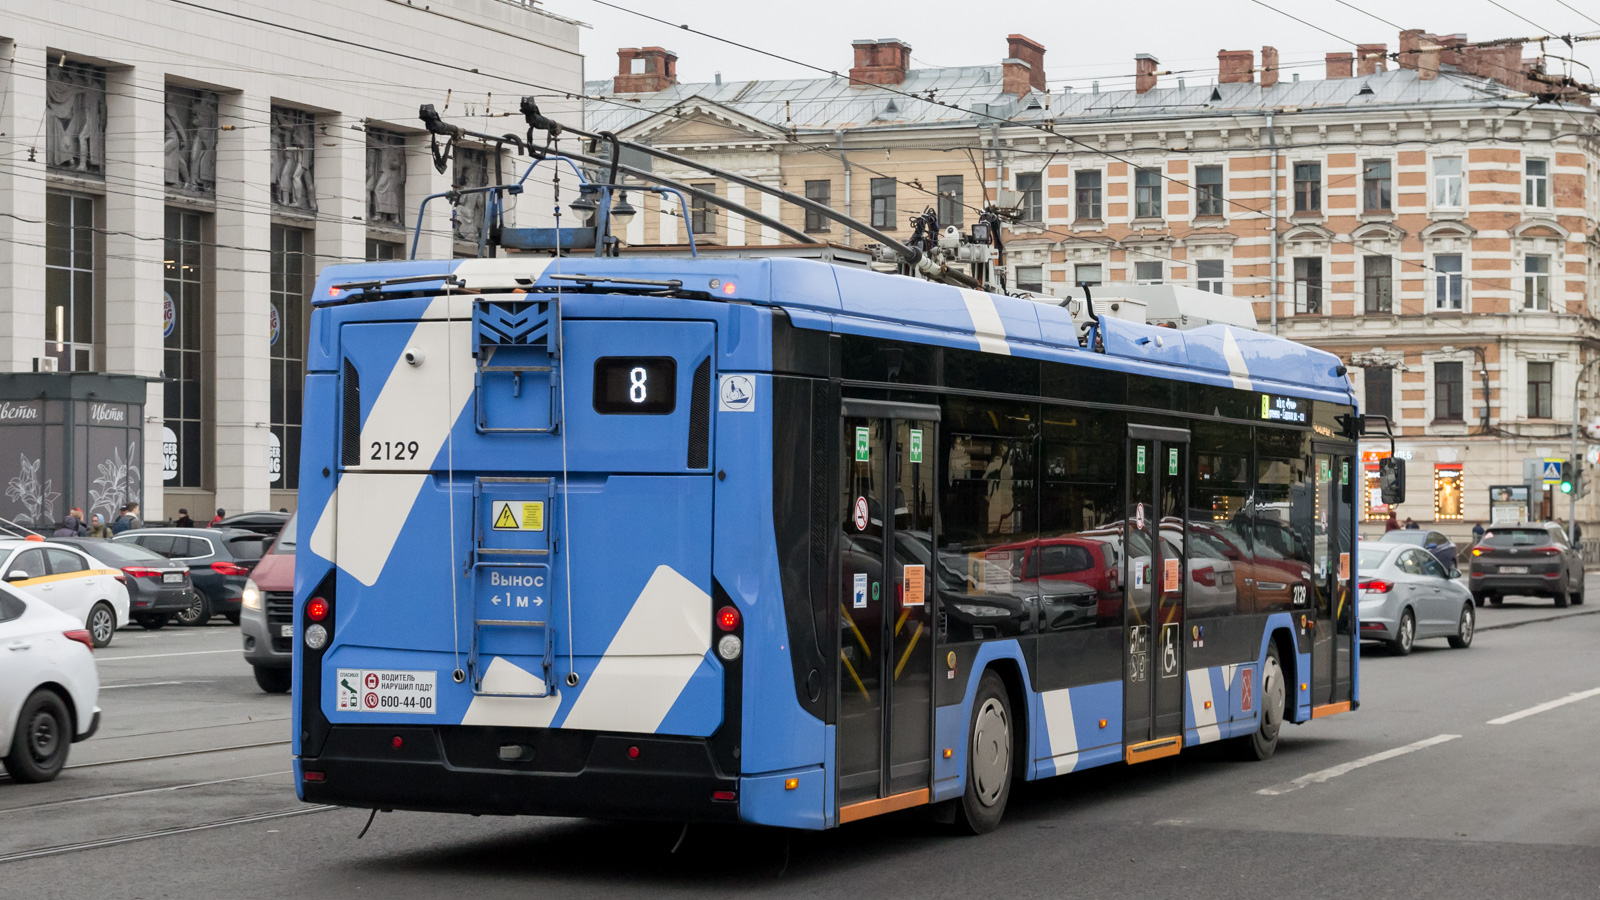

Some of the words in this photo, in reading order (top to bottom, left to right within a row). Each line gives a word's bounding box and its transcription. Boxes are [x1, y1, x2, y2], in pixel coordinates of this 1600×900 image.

[629, 367, 647, 403] 8
[0, 402, 39, 420] веты
[91, 403, 125, 423] Цветы
[371, 441, 419, 460] 2129
[491, 571, 544, 588] Вынос
[505, 592, 511, 607] 1
[1293, 585, 1307, 604] 2129
[381, 674, 415, 682] ВОДИТЕЛЬ
[381, 682, 413, 691] НАРУШИЛ
[415, 683, 433, 692] ПДД?
[381, 695, 432, 709] 600-44-00
